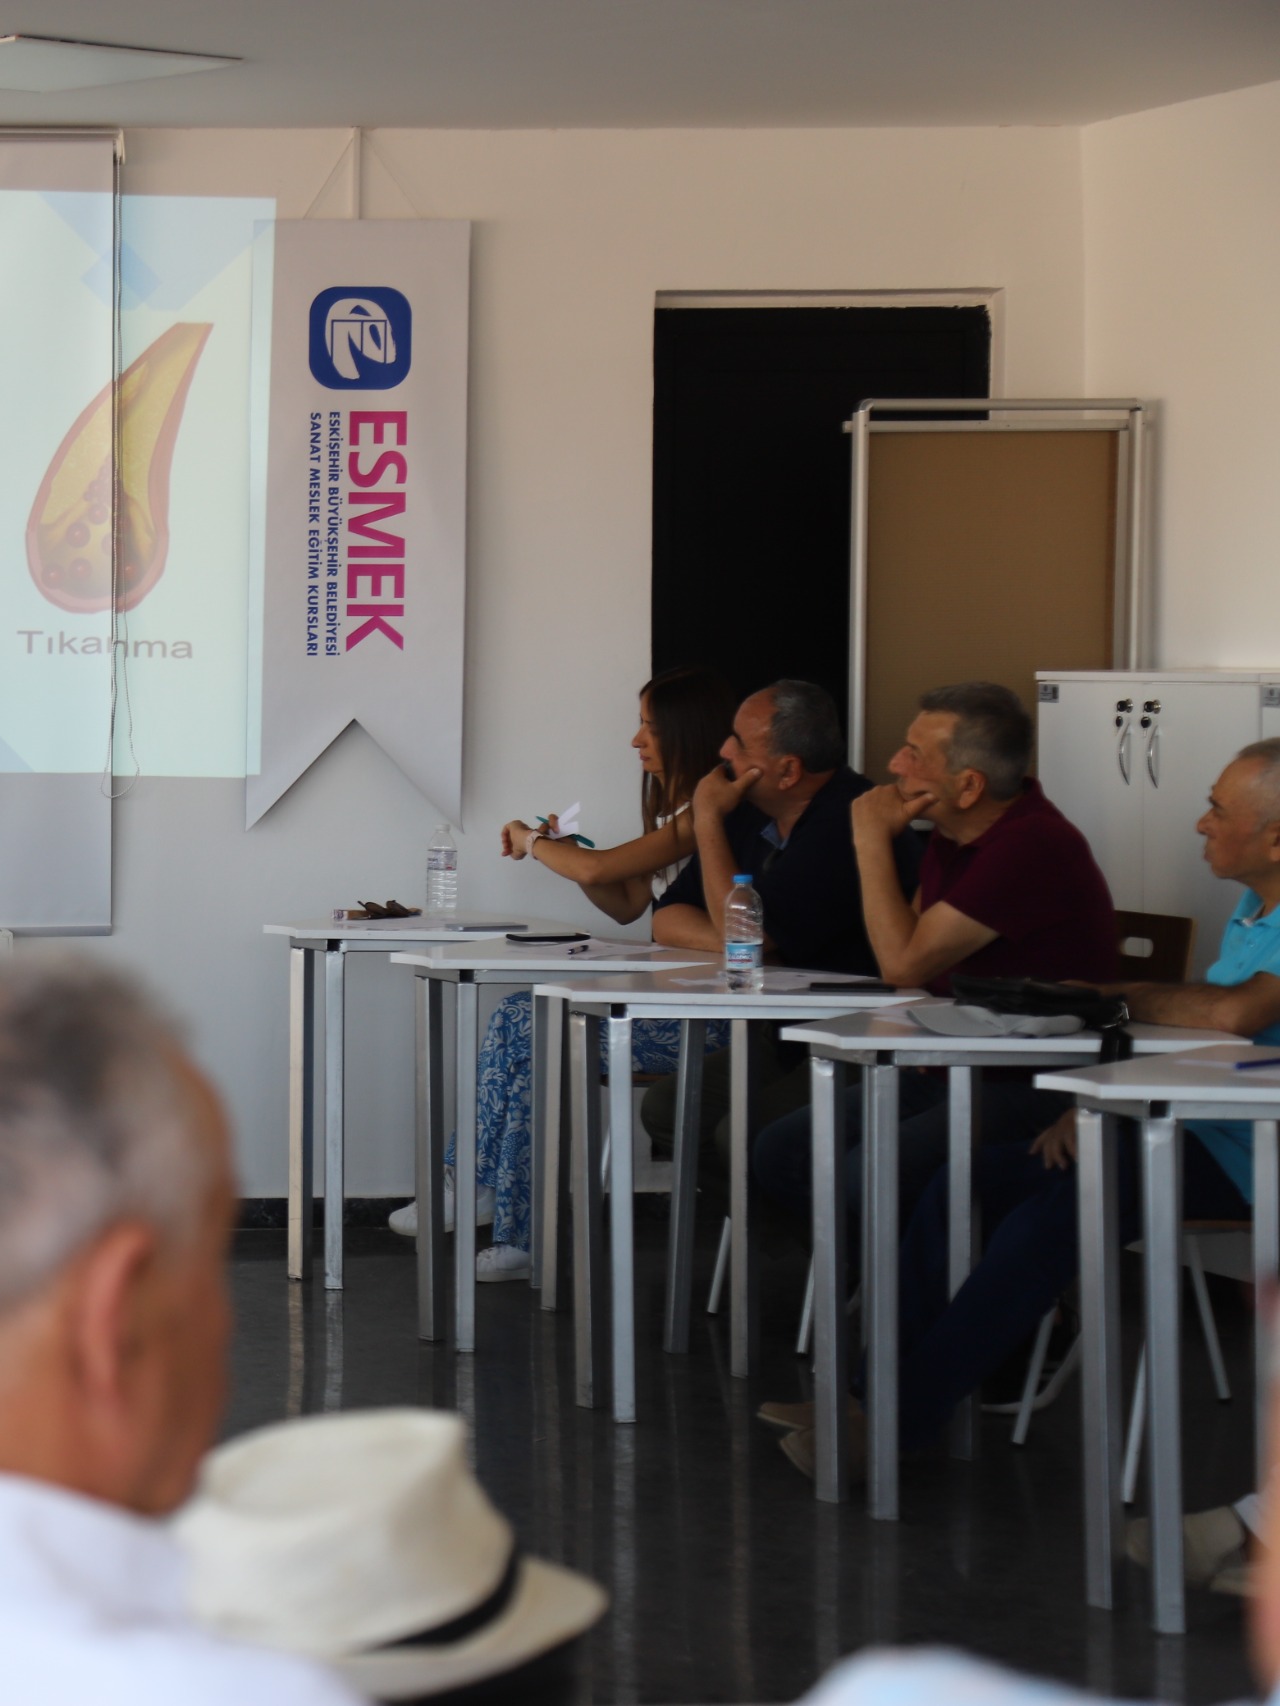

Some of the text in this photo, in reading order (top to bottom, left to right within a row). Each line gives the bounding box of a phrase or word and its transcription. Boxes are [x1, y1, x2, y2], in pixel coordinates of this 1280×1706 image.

[17, 629, 193, 659] Tıkanma
[306, 412, 322, 656] SANAT MESLEK EĞİTİM KURSLARI
[324, 411, 344, 656] ESKİŞEHİR BÜYÜKŞEHİR BELEDİYESİ
[346, 411, 407, 652] ESMEK
